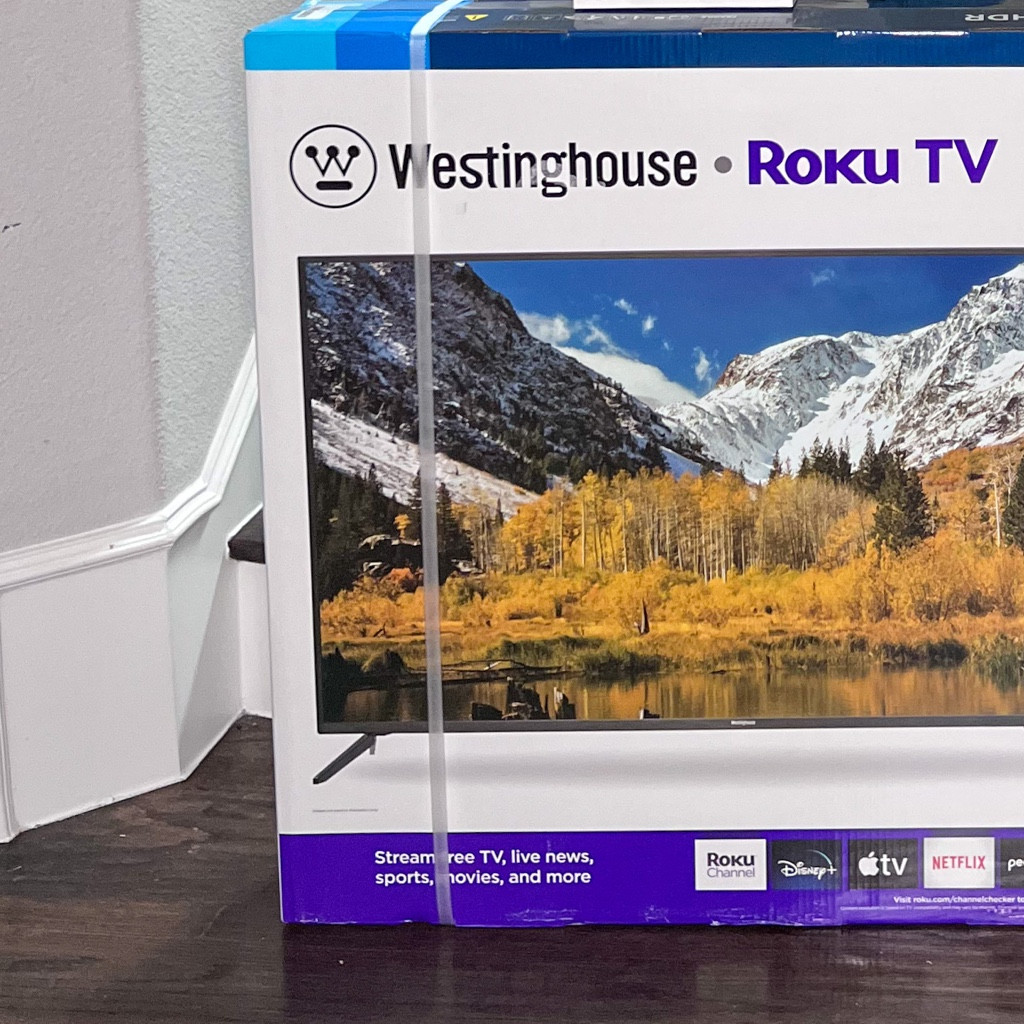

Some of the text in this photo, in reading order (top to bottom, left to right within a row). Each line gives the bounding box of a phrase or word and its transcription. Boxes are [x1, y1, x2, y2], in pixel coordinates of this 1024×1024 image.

[388, 139, 998, 198] Westinghouse Roku TV
[374, 848, 594, 865] Stream ree TV, live news,
[707, 852, 755, 867] Roku
[880, 854, 908, 876] tv
[932, 855, 986, 870] NETFLIX
[375, 871, 434, 887] sports,
[508, 869, 540, 883] and
[546, 872, 590, 883] more
[707, 867, 756, 878] Channel
